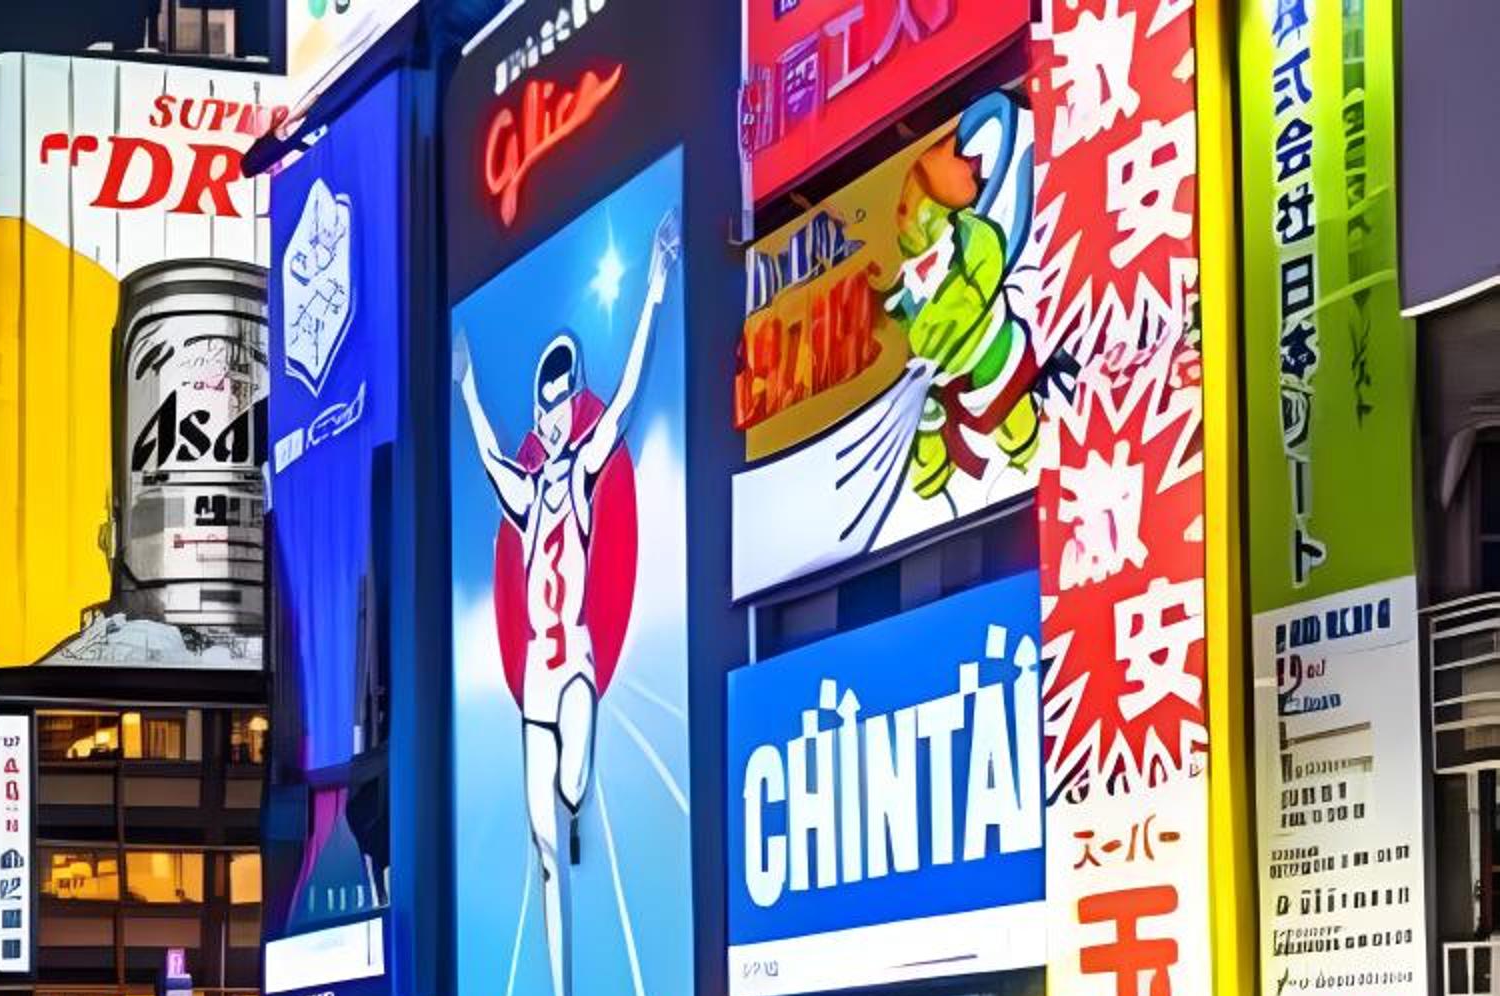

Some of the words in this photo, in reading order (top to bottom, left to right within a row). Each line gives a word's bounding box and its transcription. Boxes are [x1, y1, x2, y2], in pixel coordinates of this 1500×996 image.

[131, 389, 269, 472] Asa
[743, 634, 1044, 908] CHINTAI
[1073, 813, 1181, 869] スーパー
